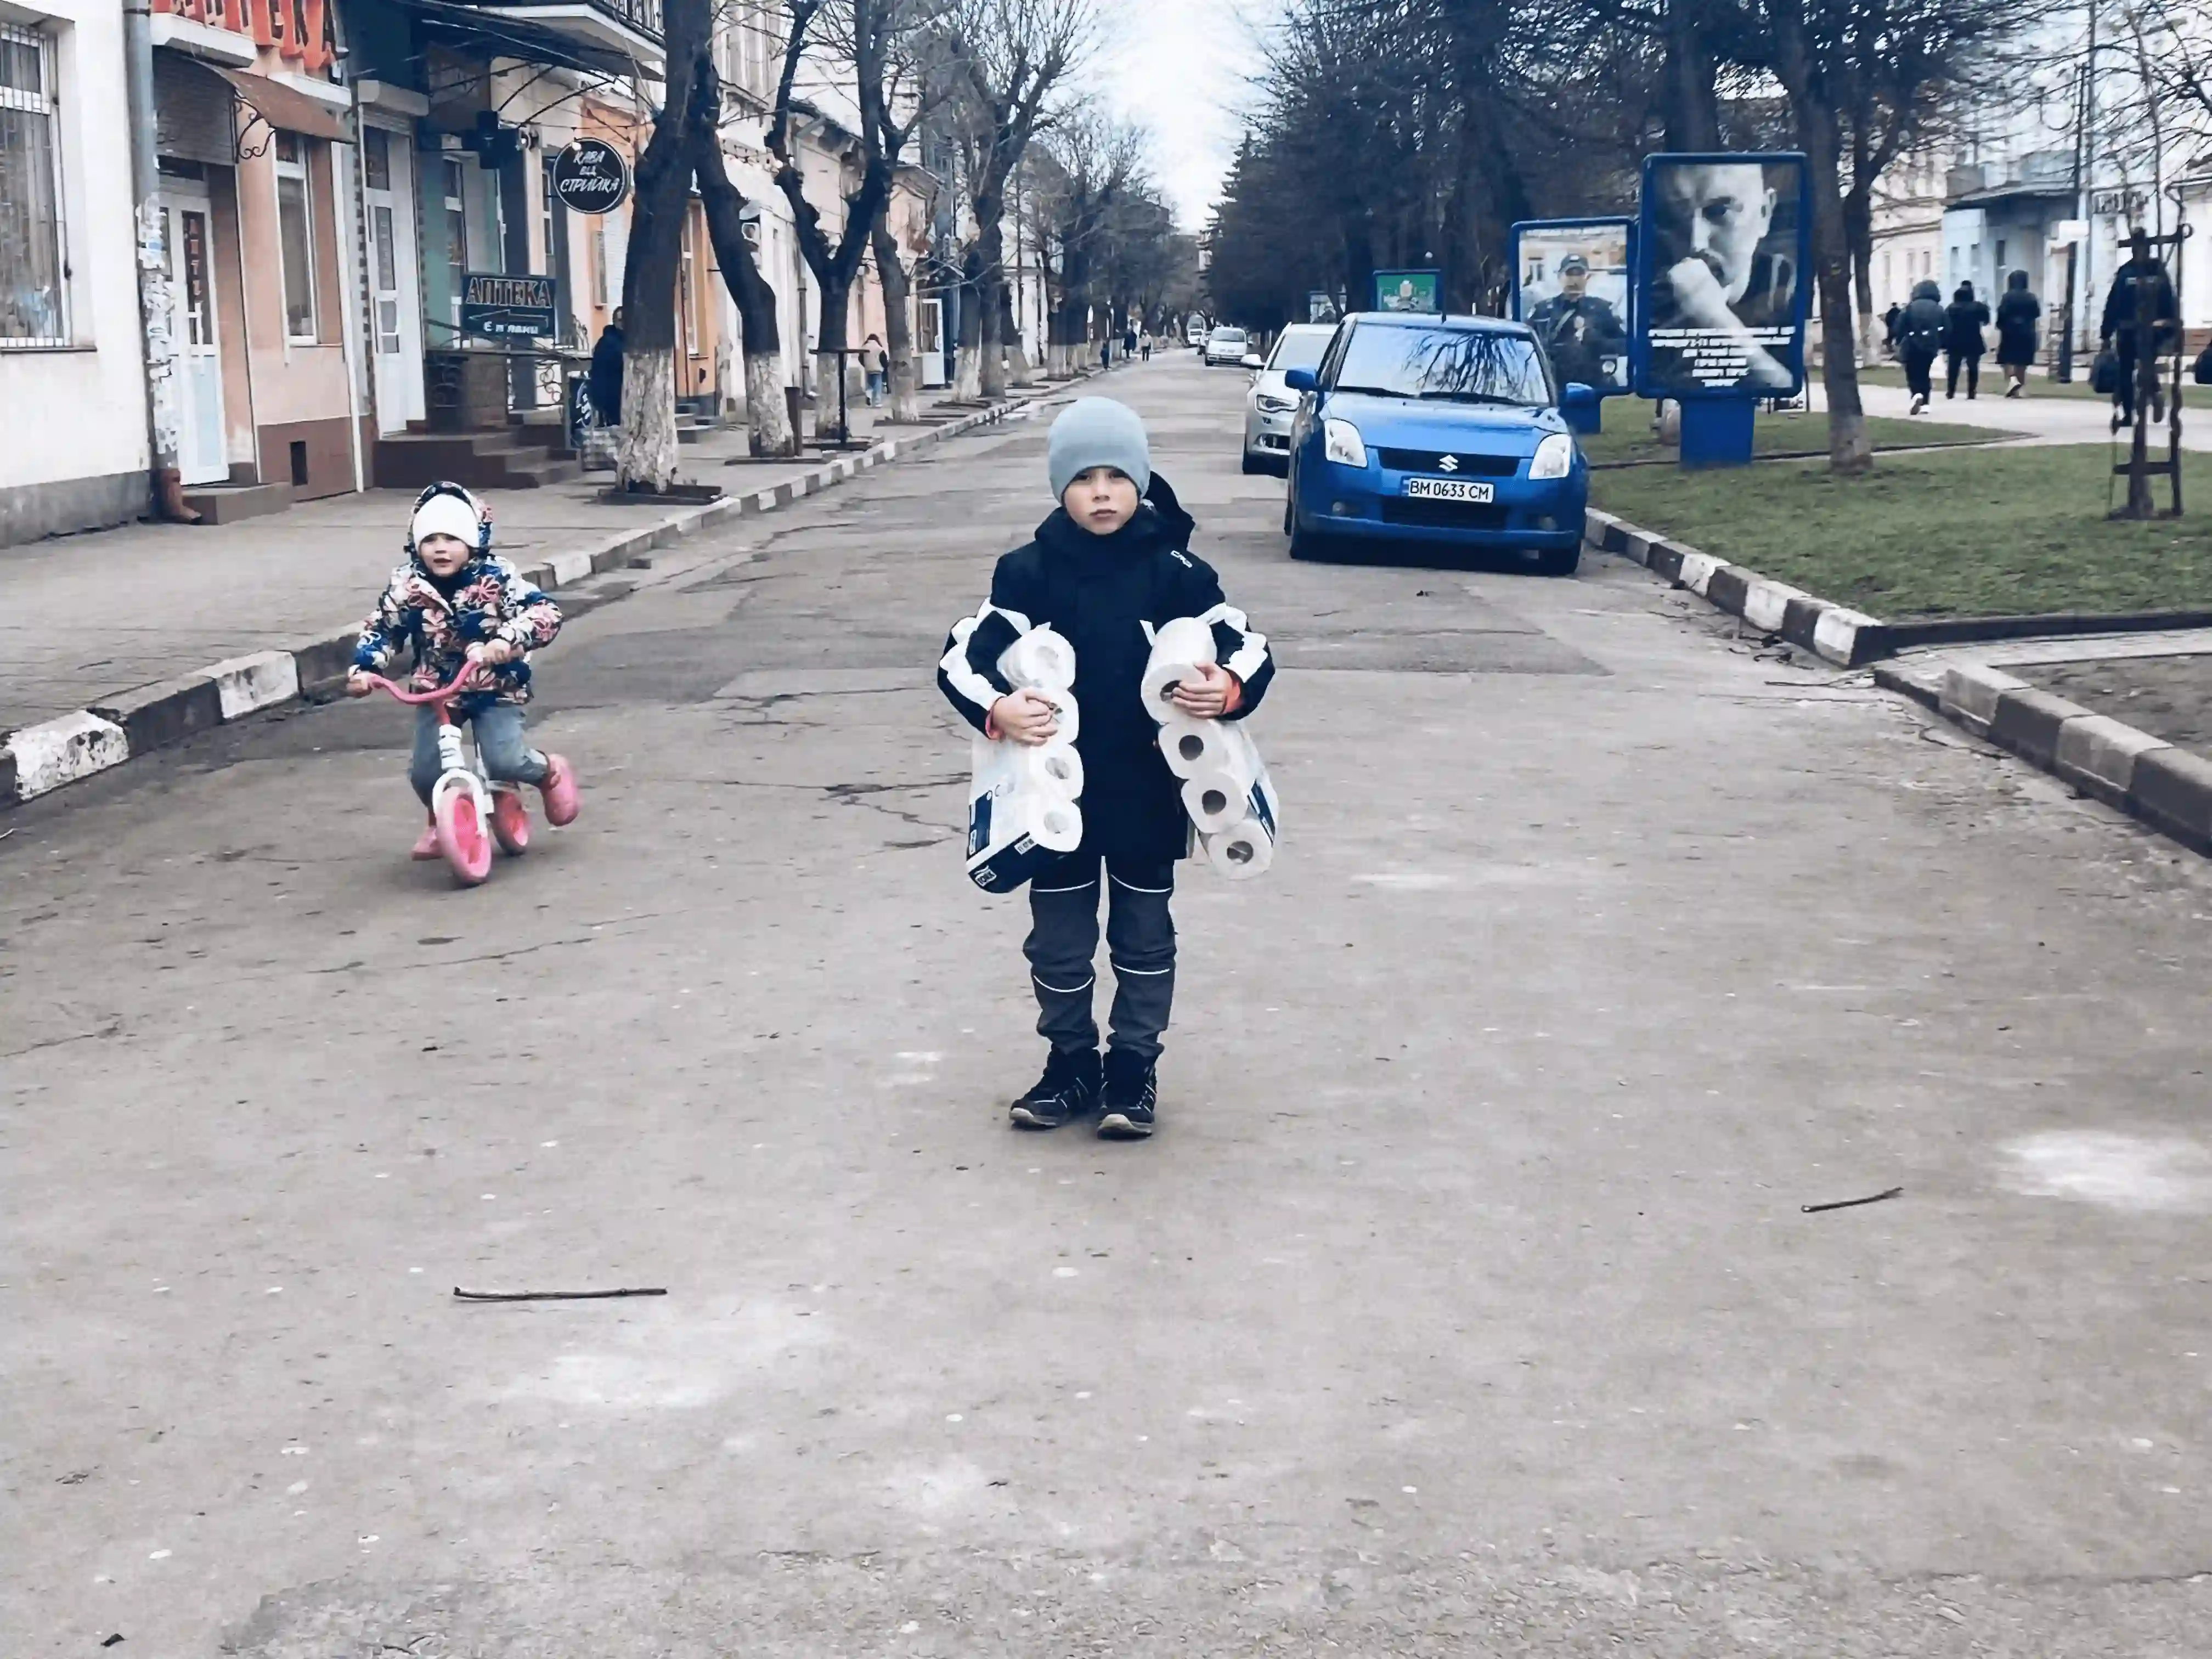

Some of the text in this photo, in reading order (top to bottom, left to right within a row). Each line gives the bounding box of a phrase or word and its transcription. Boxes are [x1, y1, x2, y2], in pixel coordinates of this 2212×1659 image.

[573, 151, 606, 165] КАВА
[560, 176, 620, 193] СТРИЙКА
[466, 277, 552, 308] АПТЕКА
[1410, 481, 1489, 500] BM 0633 CM
